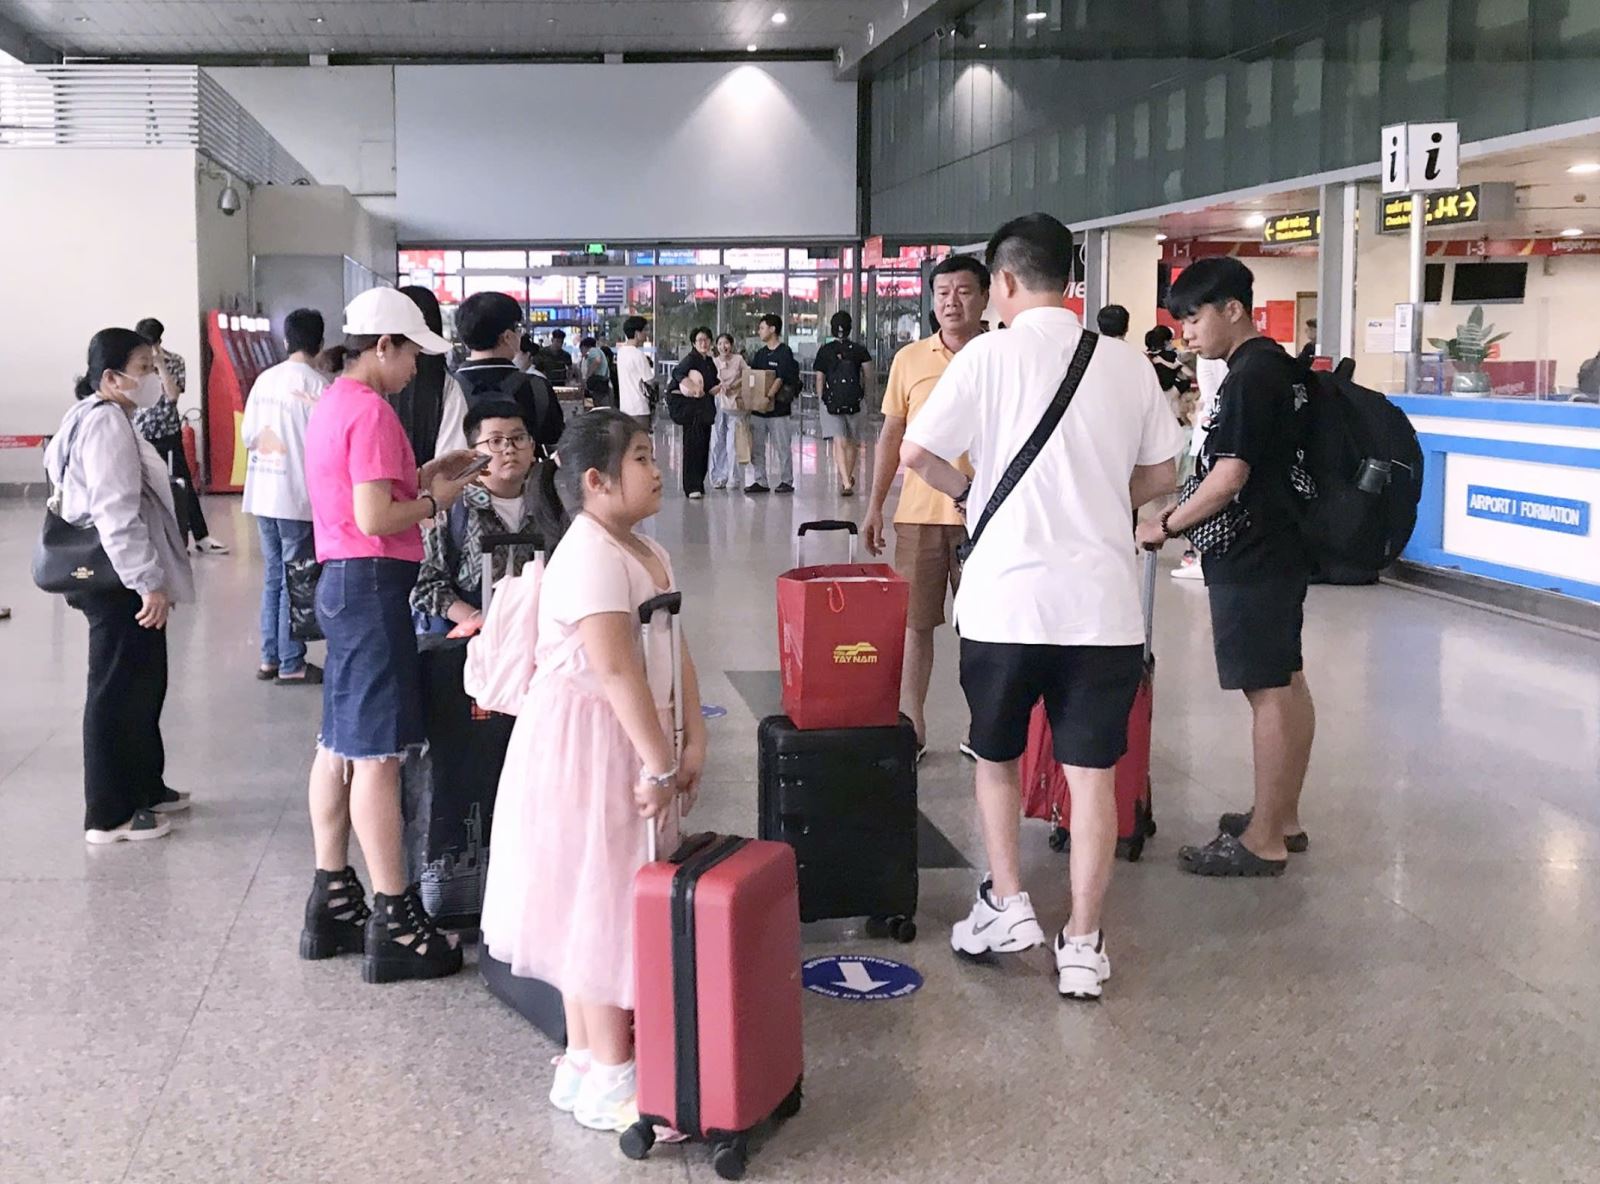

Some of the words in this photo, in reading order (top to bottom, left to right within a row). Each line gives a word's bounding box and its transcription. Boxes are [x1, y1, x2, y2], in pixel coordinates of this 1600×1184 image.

[1389, 136, 1398, 183] i
[1425, 132, 1442, 180] i
[1434, 195, 1459, 219] J-K
[1470, 493, 1511, 514] AIRPORT
[1520, 501, 1580, 526] FORMATION
